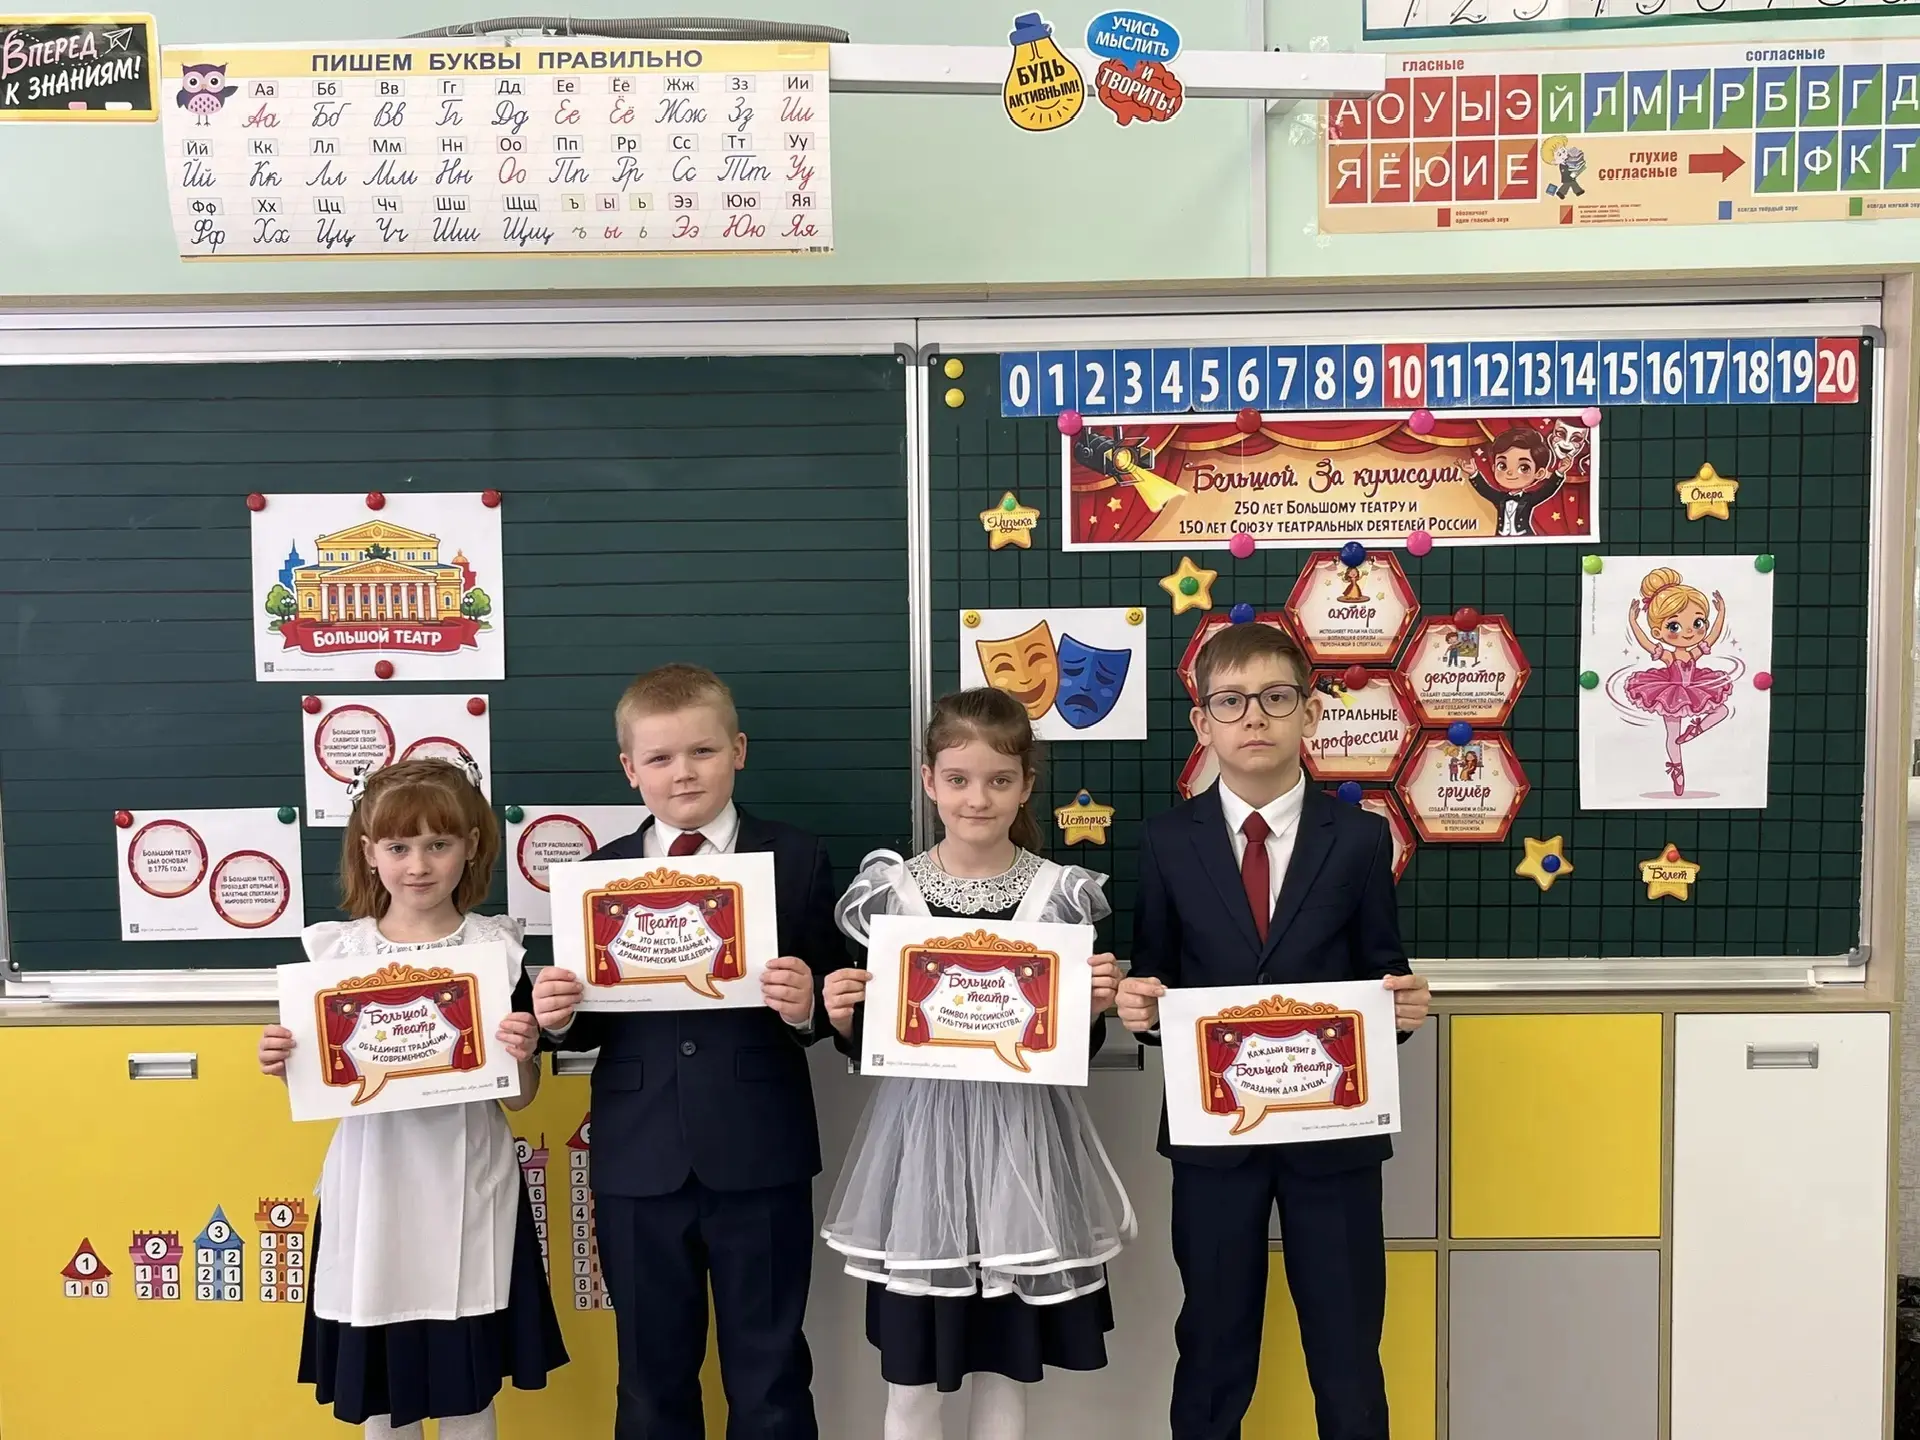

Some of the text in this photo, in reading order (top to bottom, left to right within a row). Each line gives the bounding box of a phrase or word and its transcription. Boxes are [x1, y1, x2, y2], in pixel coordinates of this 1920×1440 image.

[1111, 15, 1159, 38] УЧИСЬ
[1094, 31, 1170, 57] МЫСЛИТЬ
[312, 49, 703, 72] ПИШЕМ БУКВЫ ПРАВИЛЬНО
[1402, 47, 1826, 72] гласные согласные
[5, 56, 141, 104] К ЗНАНИЯМ!
[1016, 60, 1066, 87] БУДЬ
[1142, 66, 1154, 82] И
[1008, 80, 1080, 109] АКТИВНЫМ!
[1101, 66, 1176, 113] ТВОРИТЬ!
[1629, 149, 1678, 165] глухие
[1598, 164, 1678, 181] согласные
[1009, 349, 1857, 408] 0 1 2 3 4 5 6 7 8 9 10 11 12 13 14 15 16 17 18 19 20
[1184, 458, 1463, 498] Большой. За кулисами.
[1691, 487, 1725, 505] Опера
[1234, 501, 1260, 515] 250
[987, 515, 1033, 533] Музыка
[1179, 520, 1203, 533] 150
[1328, 604, 1377, 628] актёр
[313, 627, 442, 648] БОЛЬШОЙ ТЕАТР
[1422, 669, 1506, 692] декоратор
[1322, 709, 1398, 721] АТРАЛЬНЫЕ
[1437, 784, 1491, 807] гримёр
[1060, 812, 1109, 831] История
[1648, 865, 1688, 881] Балет
[634, 911, 687, 935] Театр
[944, 972, 1006, 990] Большой
[363, 1004, 429, 1025] Большой
[392, 1020, 436, 1039] театр
[1231, 1062, 1289, 1077] Большой
[276, 1208, 287, 1224] 4
[214, 1224, 224, 1239] 3
[151, 1241, 161, 1256] 2
[82, 1256, 91, 1271] 1
